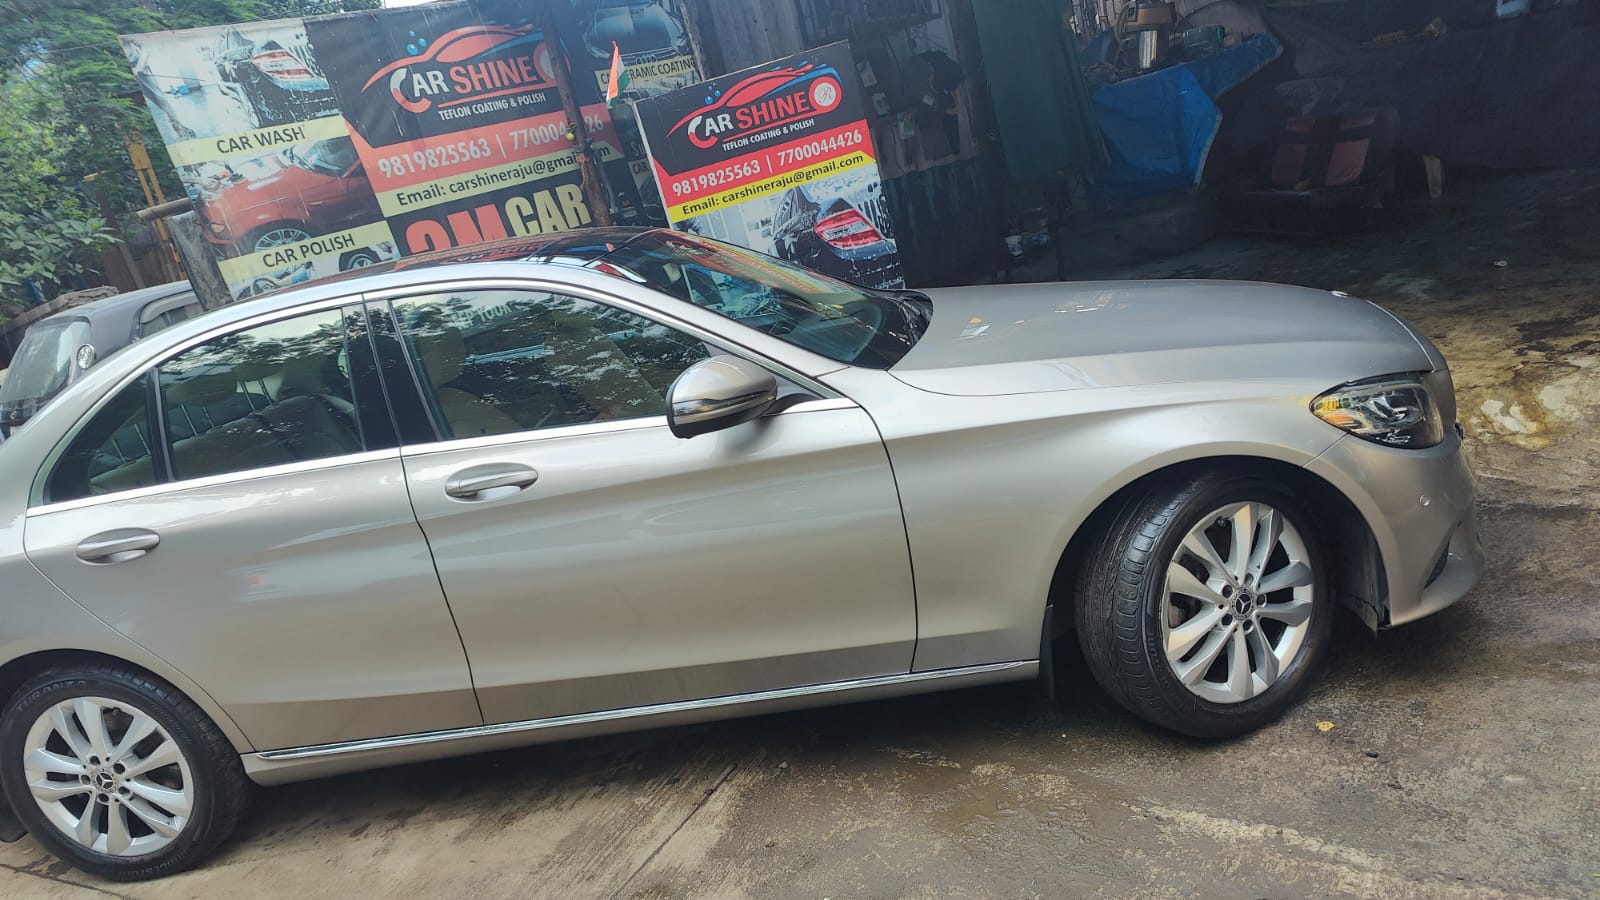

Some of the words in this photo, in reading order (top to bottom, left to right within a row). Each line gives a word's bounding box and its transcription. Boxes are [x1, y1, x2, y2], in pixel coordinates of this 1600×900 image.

[390, 68, 450, 113] CAR
[450, 56, 537, 94] SHINE
[438, 107, 472, 121] TEFLON
[472, 99, 509, 116] COATING
[510, 98, 517, 108] &
[517, 92, 546, 106] POLISH
[216, 136, 253, 154] CAR
[253, 126, 306, 147] WASH
[378, 138, 491, 178] 9819825563
[509, 113, 604, 153] 77000426
[688, 115, 733, 149] CAR
[735, 92, 809, 129] SHINE
[722, 137, 749, 151] TEFLON
[750, 129, 782, 144] COATING
[783, 126, 789, 134] &
[790, 118, 815, 131] POLISH
[672, 160, 761, 197] 9819825563
[778, 130, 863, 167] 7700044426
[682, 197, 719, 215] Email:
[722, 154, 864, 203] carshineraju@gmail.com
[397, 184, 447, 207] Email:
[505, 183, 592, 237] CAR
[262, 248, 298, 268] CAR
[300, 234, 355, 259] POLISH
